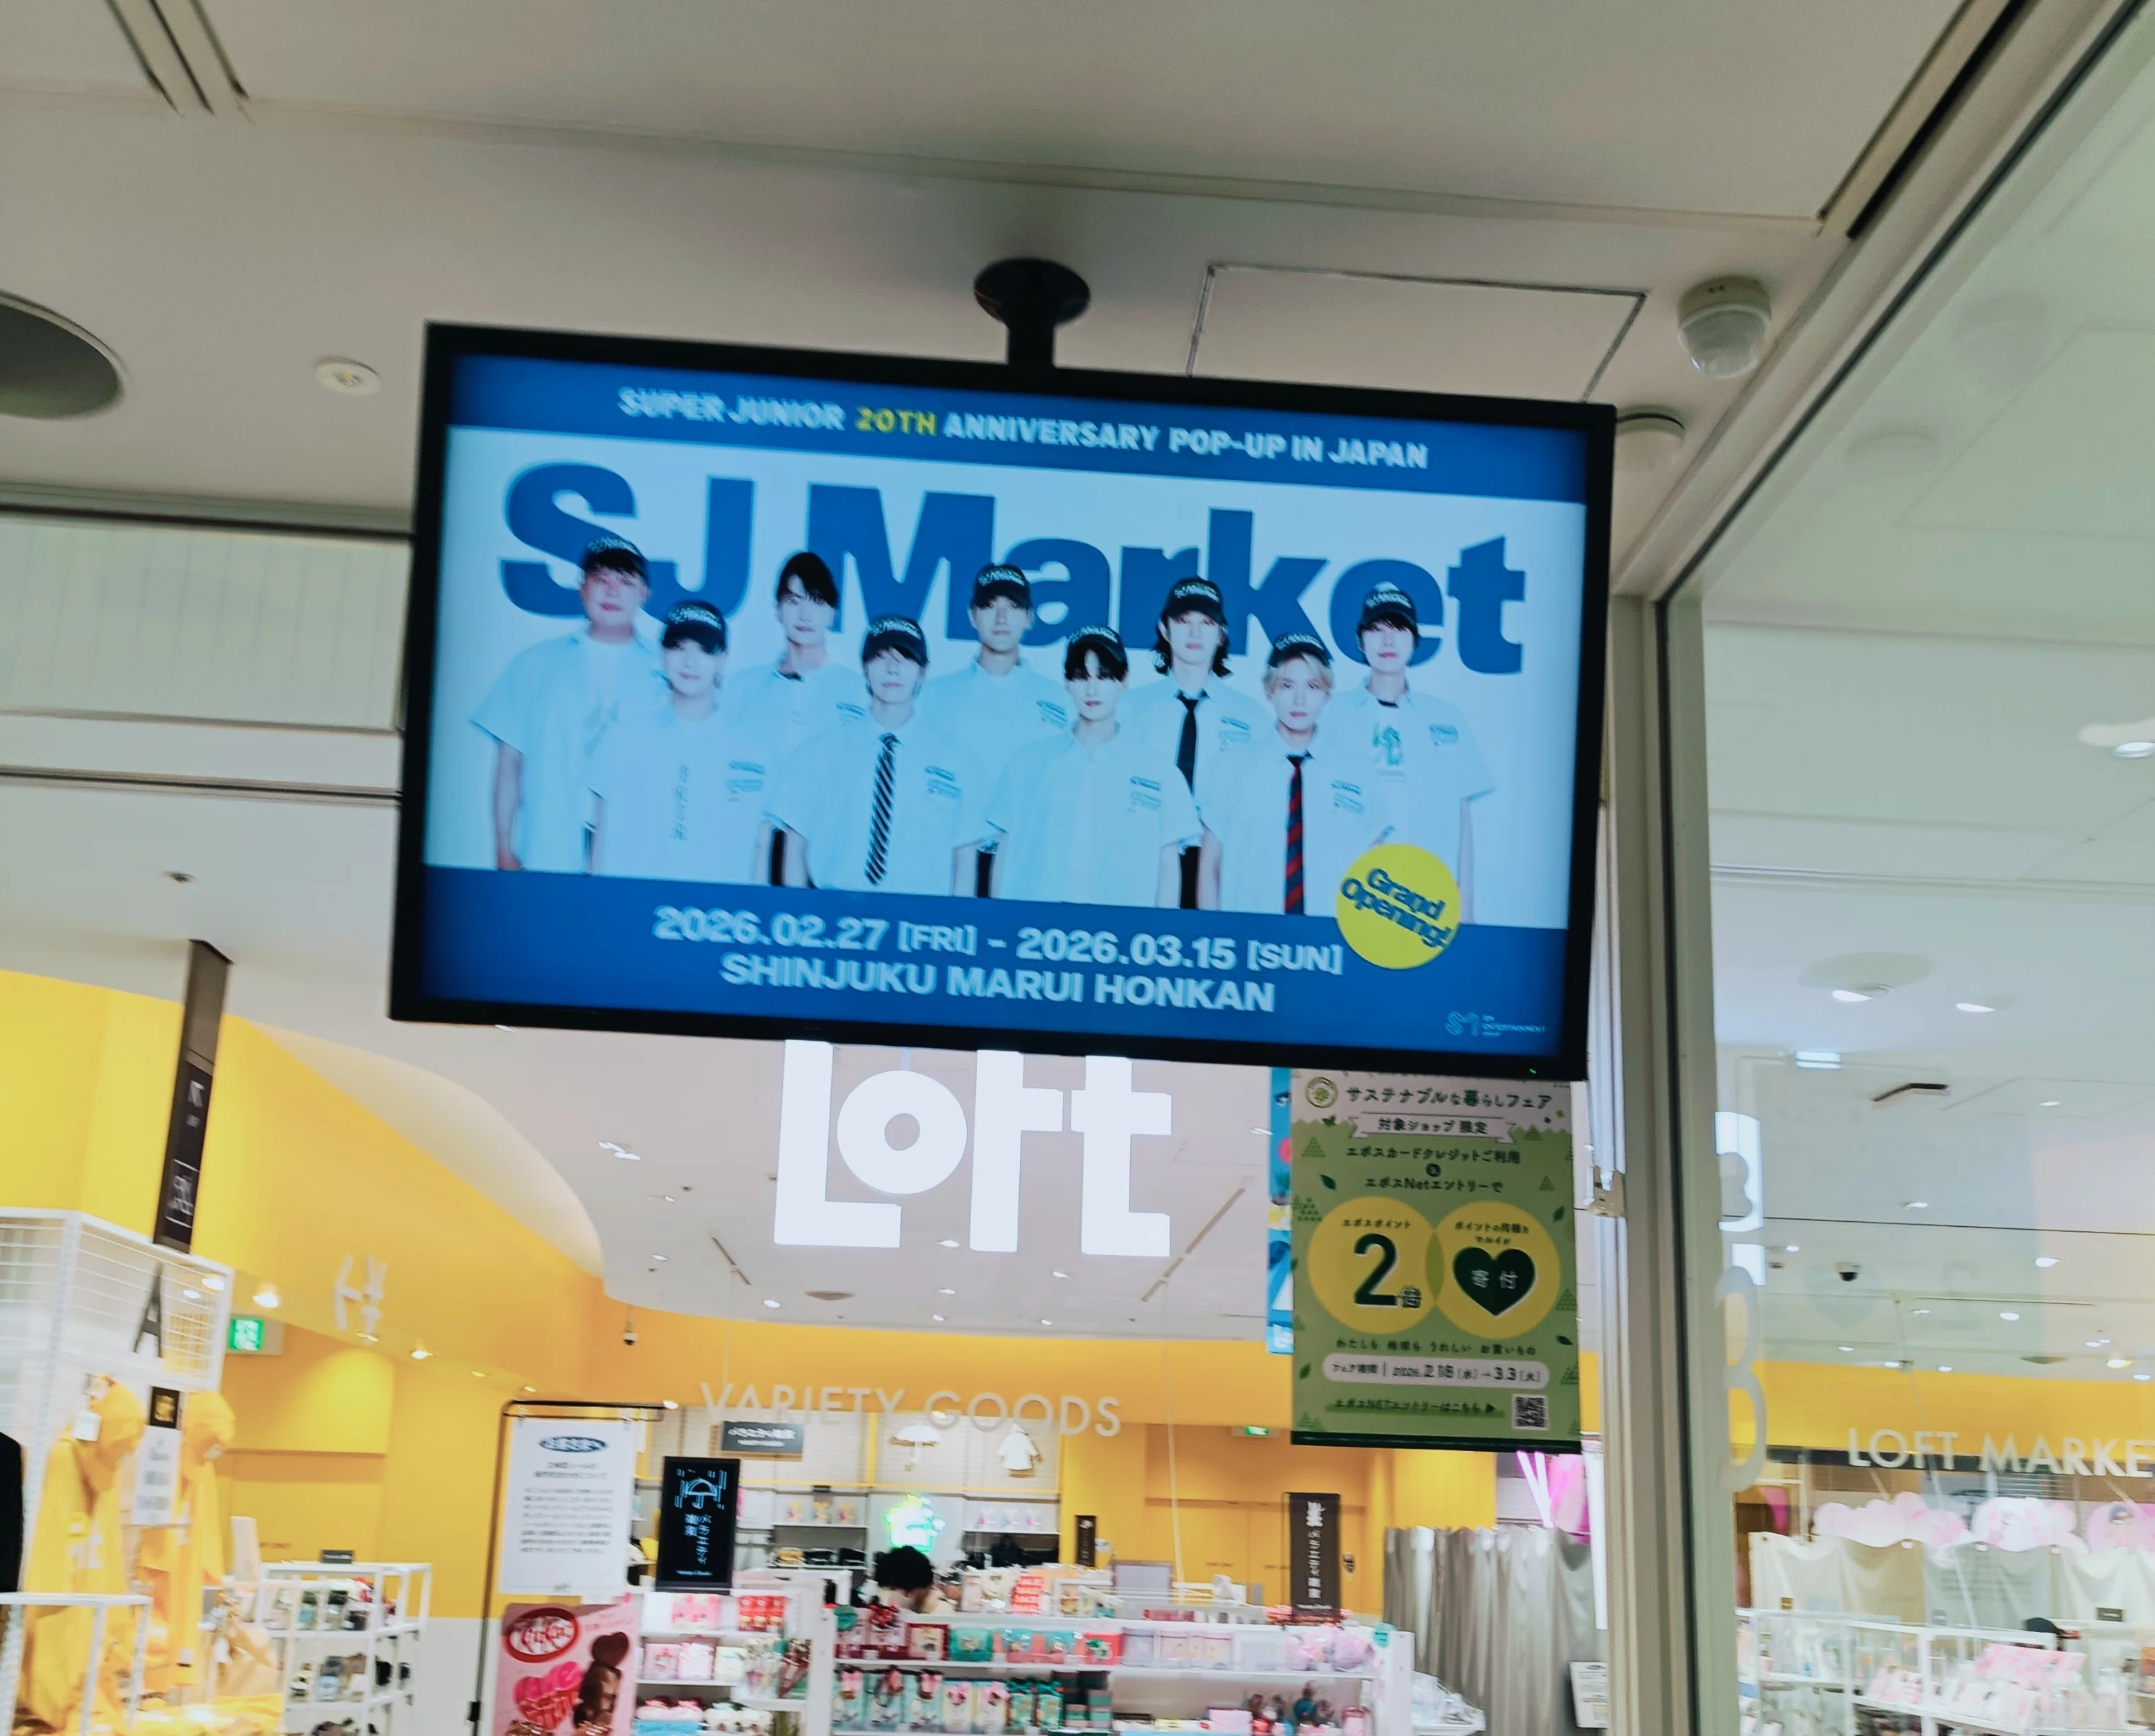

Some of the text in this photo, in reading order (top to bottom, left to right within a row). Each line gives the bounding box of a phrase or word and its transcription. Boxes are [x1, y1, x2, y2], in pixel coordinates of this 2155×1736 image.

[617, 386, 1429, 470] SUPER JUNIOR 20TH ANNIVERSARY POP-UP IN JAPAN
[499, 462, 1526, 676] SJ Market
[1339, 878, 1456, 949] Opening!
[1366, 867, 1446, 923] Grand
[652, 904, 890, 951] 2026.02.27
[898, 920, 978, 957] [FRI]
[1016, 926, 1238, 971] 2026.03.15
[1247, 939, 1343, 976] [SUN]
[719, 952, 1276, 1013] SHINJUKU MARUI HONKAN
[1346, 1087, 1552, 1109] サステナブルな暮らしフェア
[699, 1382, 1123, 1438] VARIETY GOODS
[1847, 1428, 2155, 1478] LOFT MARKE
